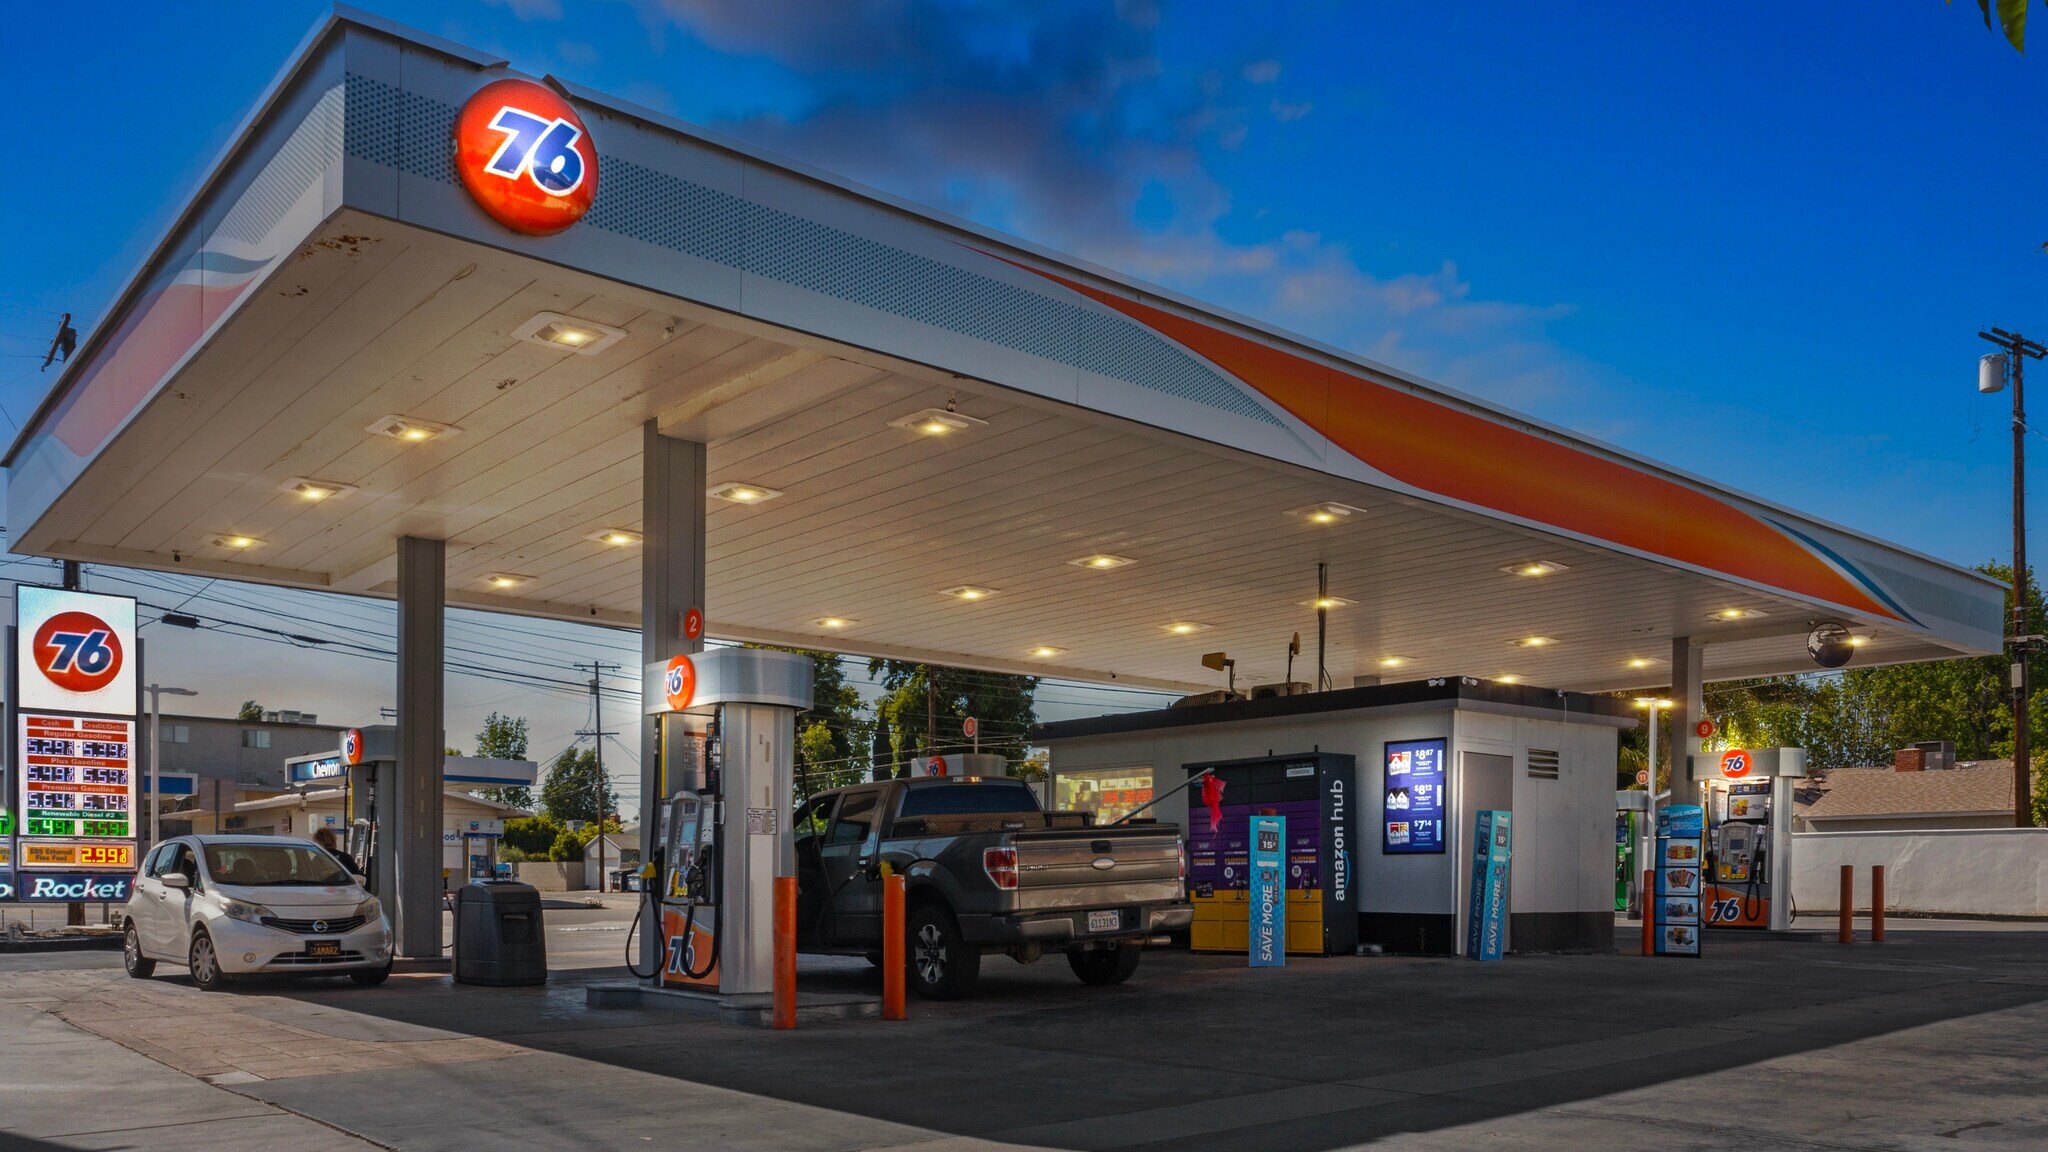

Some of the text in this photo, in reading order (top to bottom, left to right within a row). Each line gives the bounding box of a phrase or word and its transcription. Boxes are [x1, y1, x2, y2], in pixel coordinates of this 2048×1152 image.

[484, 105, 583, 197] 76
[690, 615, 697, 632] 2
[46, 629, 113, 677] 76
[666, 665, 684, 696] 76
[43, 730, 112, 740] Regular Gasoline
[83, 722, 127, 731] Credit/Debit
[1701, 724, 1708, 734] 9
[312, 760, 340, 778] Chevron
[928, 761, 940, 776] 76
[1725, 755, 1745, 772] 76
[1259, 831, 1279, 841] SAVE
[1330, 780, 1345, 902] amazon hub
[30, 878, 126, 898] Rocket
[1474, 879, 1483, 918] MORE
[1488, 879, 1502, 955] SAVE MORE
[1710, 897, 1740, 922] 76
[1262, 884, 1273, 962] SAVE MORE
